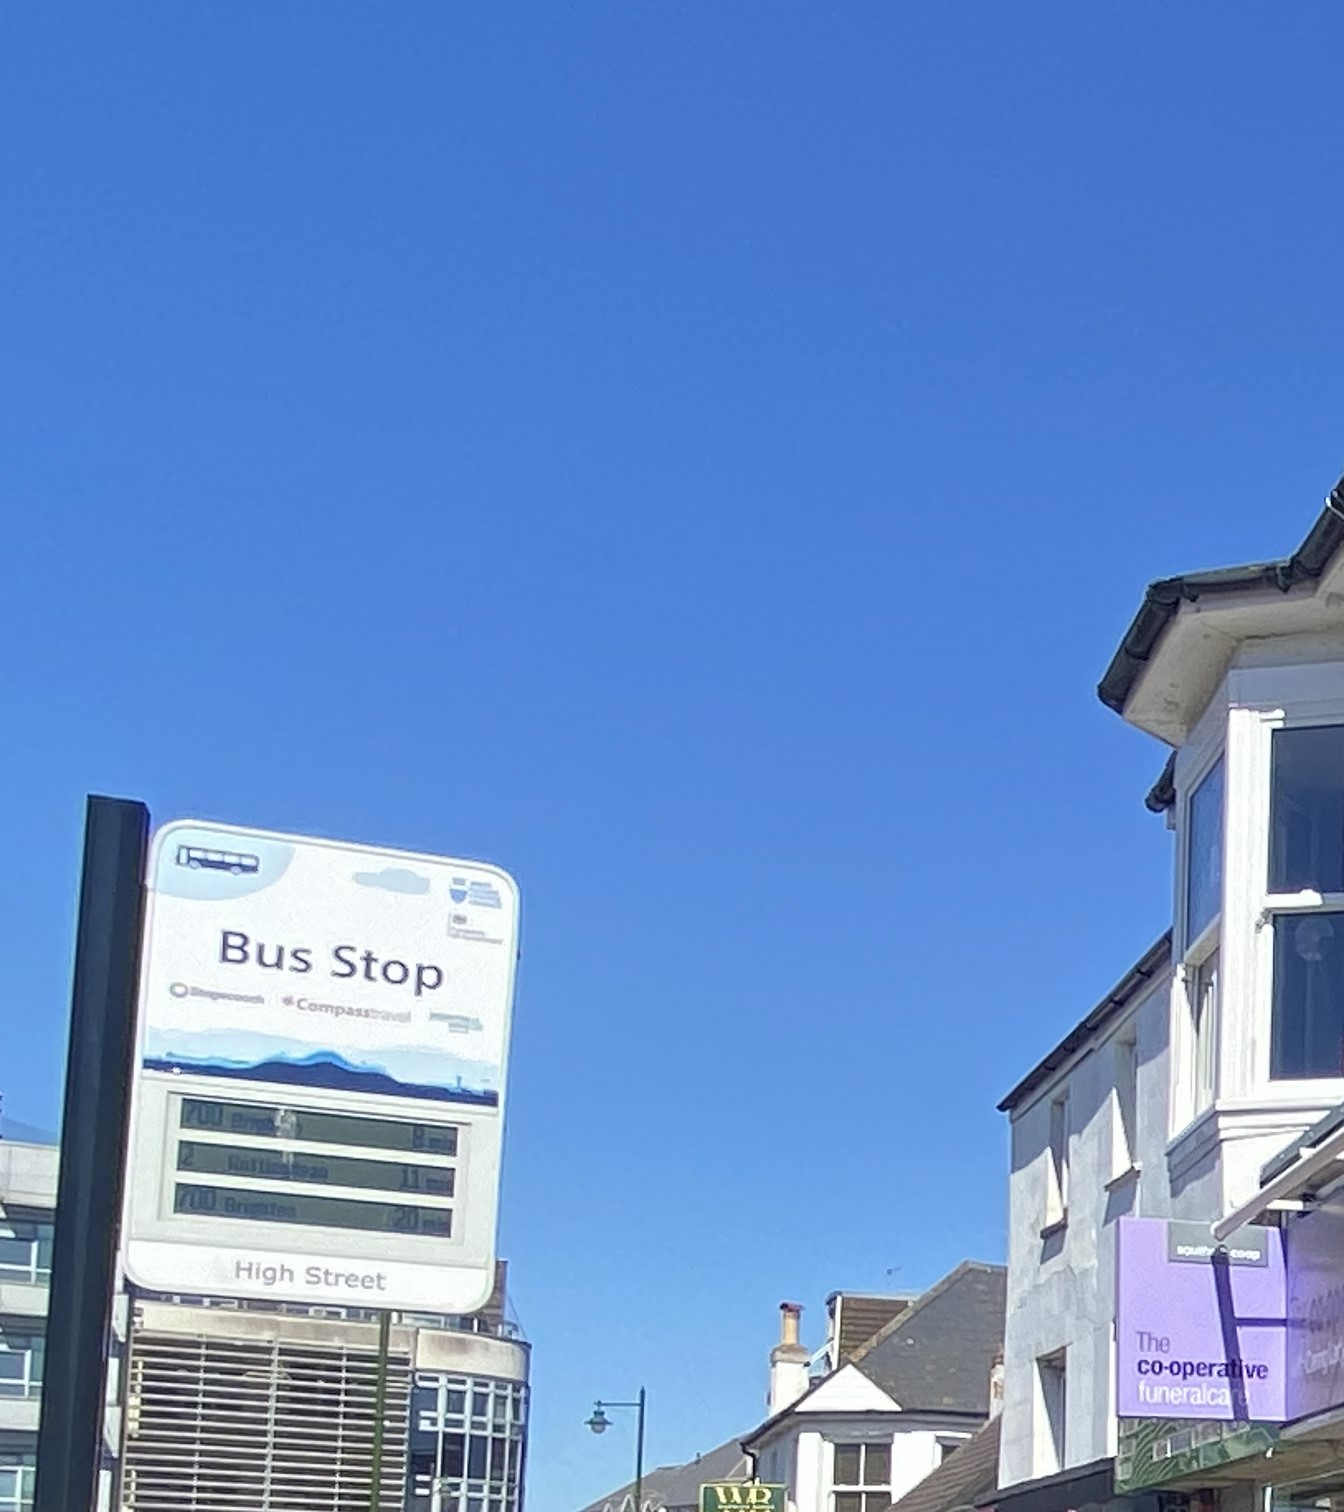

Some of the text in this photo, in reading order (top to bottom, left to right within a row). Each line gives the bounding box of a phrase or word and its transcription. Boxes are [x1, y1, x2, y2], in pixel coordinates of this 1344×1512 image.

[218, 929, 445, 997] Bus Stop
[234, 1259, 387, 1292] High Street
[1136, 1330, 1171, 1354] The
[1137, 1357, 1269, 1381] co-operative
